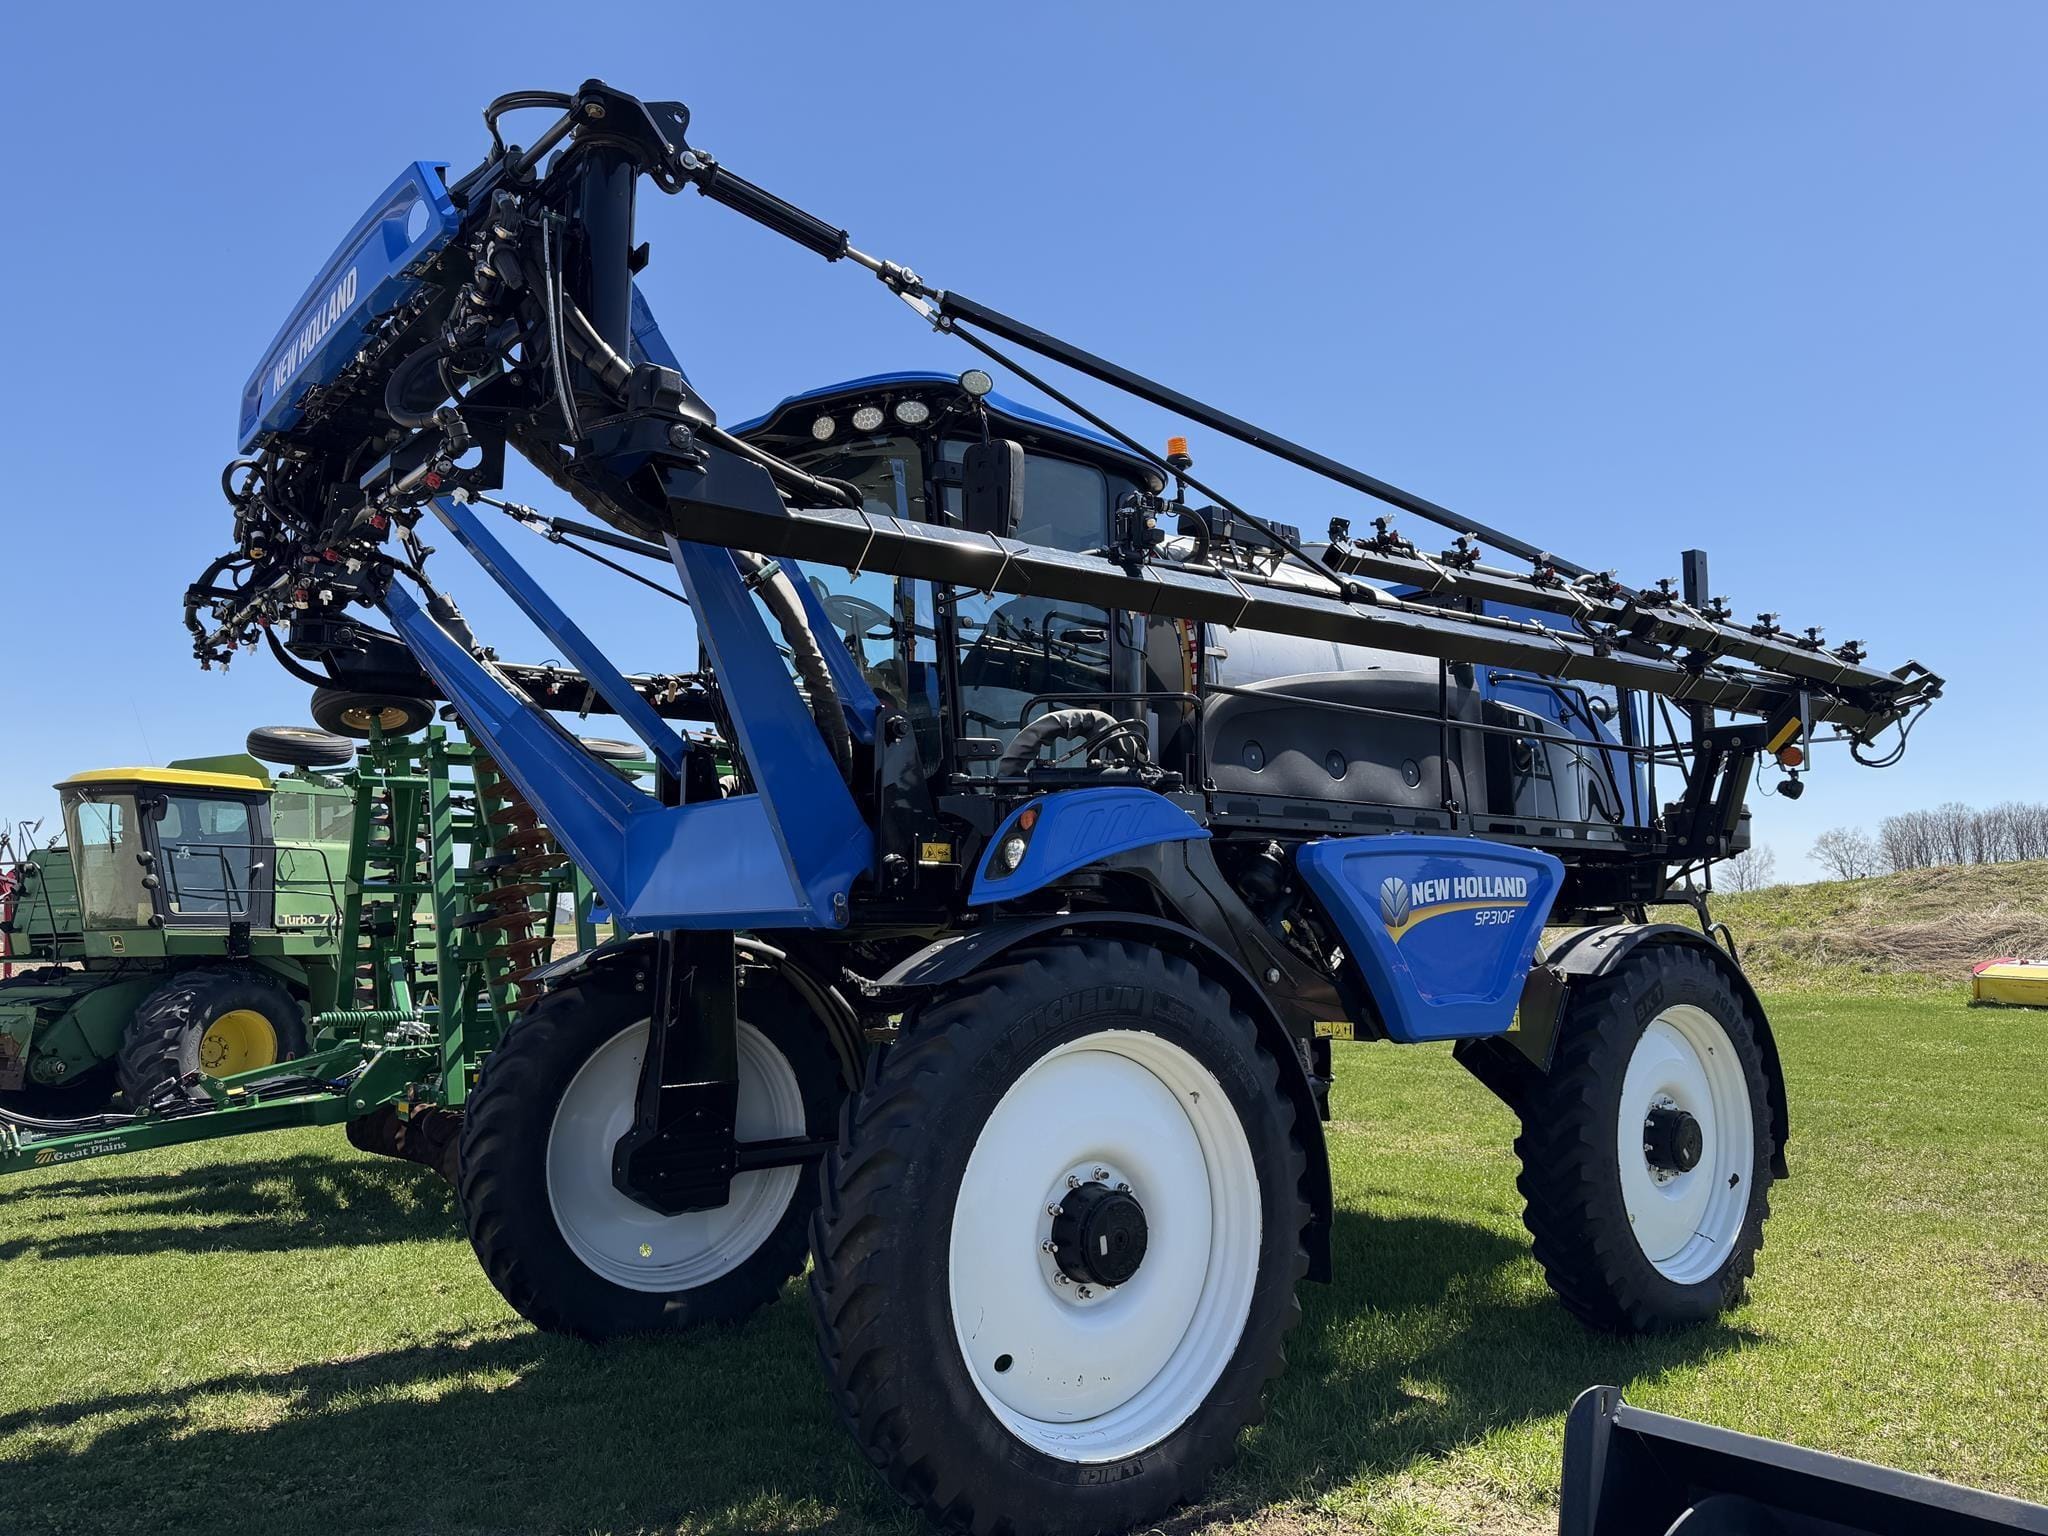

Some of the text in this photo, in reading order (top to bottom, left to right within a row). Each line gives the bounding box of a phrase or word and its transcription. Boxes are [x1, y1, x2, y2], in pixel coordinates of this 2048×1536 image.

[272, 266, 358, 396] NEW HOLLAND
[1411, 876, 1528, 906] NEW HOLLAND
[282, 913, 316, 925] Turbo
[1474, 909, 1516, 926] SP310F
[1636, 985, 1663, 1022] BKT
[1008, 985, 1143, 1056] MICHELIN
[53, 1141, 127, 1161] Great Plains
